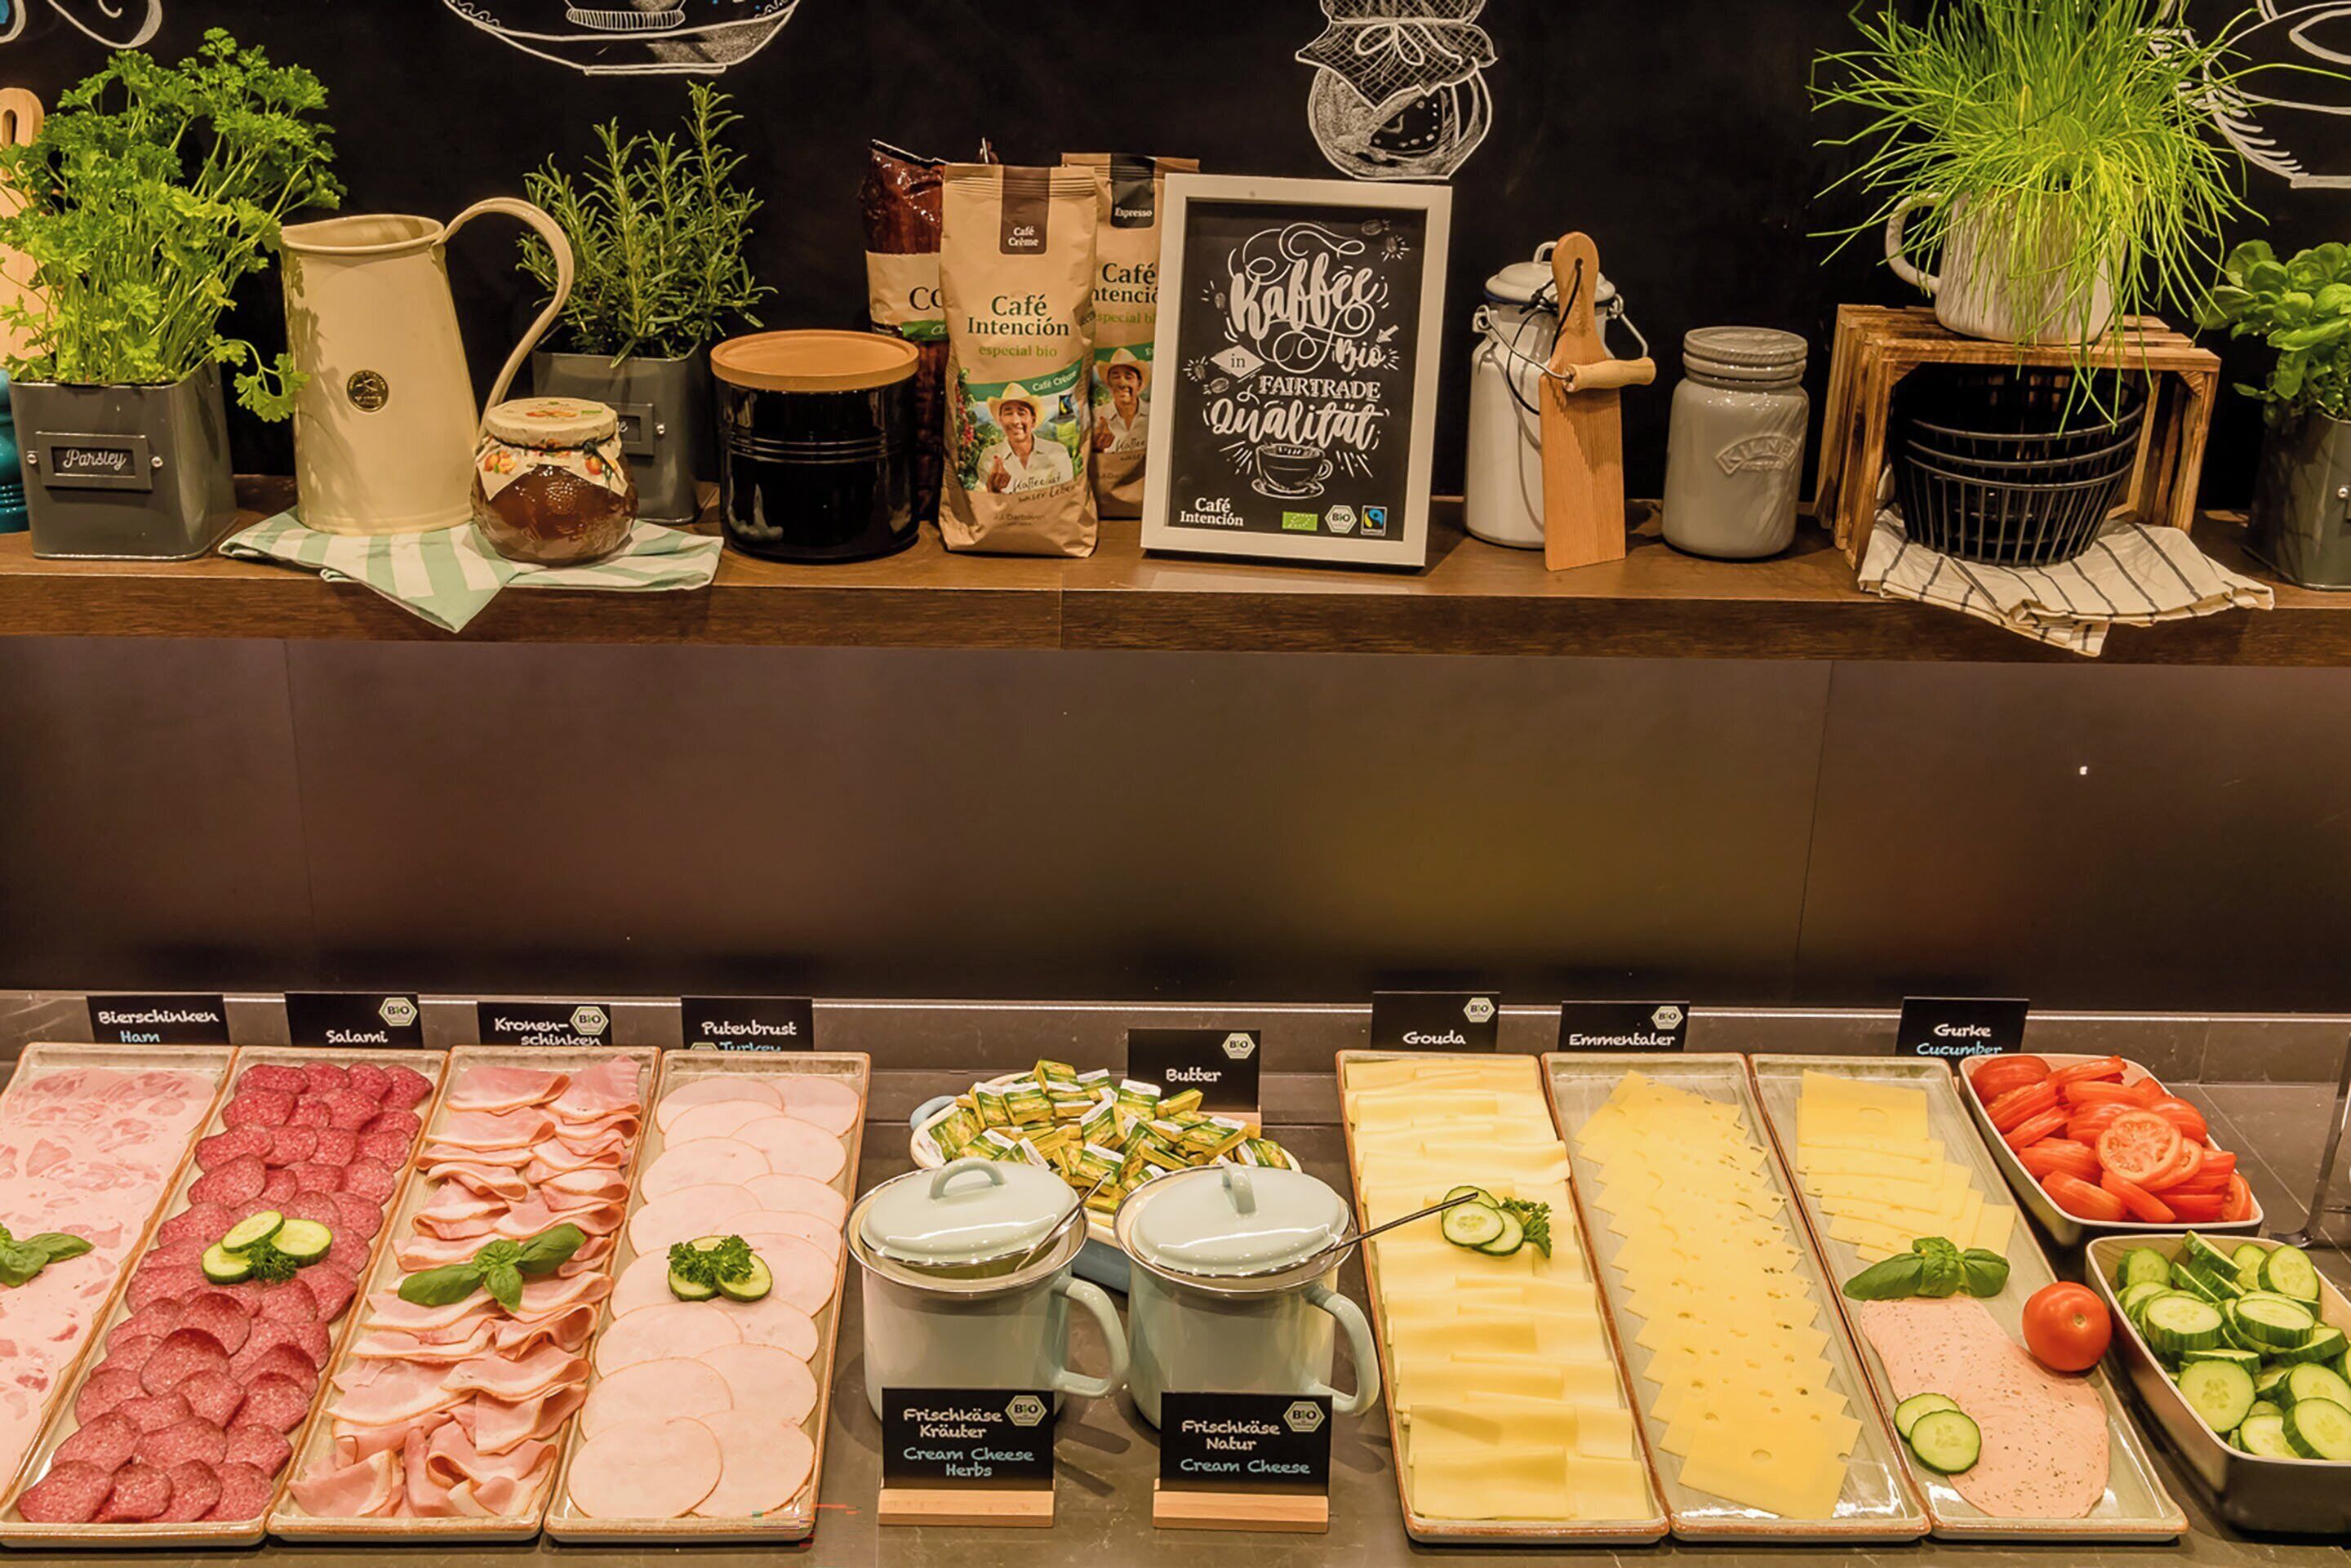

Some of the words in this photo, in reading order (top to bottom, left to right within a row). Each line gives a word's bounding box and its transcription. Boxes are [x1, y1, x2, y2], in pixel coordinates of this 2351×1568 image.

[1114, 207, 1153, 219] Espresso
[1013, 225, 1035, 236] Café
[1102, 262, 1156, 285] Café
[1229, 251, 1380, 341] Kaffee
[991, 293, 1047, 317] Café
[1096, 312, 1141, 324] special
[967, 317, 1069, 336] Intención
[979, 344, 1032, 358] especial
[1035, 345, 1058, 357] bio
[1335, 337, 1386, 372] Bio
[1230, 353, 1247, 368] in
[1032, 380, 1052, 392] Café
[1257, 375, 1382, 402] FAIRTRADE
[1210, 398, 1385, 451] Qualität
[62, 449, 127, 471] Parsley
[1195, 497, 1231, 513] Café
[1180, 510, 1244, 527] Intención
[98, 1009, 220, 1024] Bierschinken
[494, 1017, 569, 1032] Kronen-
[702, 1019, 797, 1036] Putenbrust
[1933, 1024, 1992, 1037] Gurke
[120, 1030, 160, 1043] Ham
[326, 1029, 389, 1044] Salami
[521, 1033, 602, 1046] schinken
[1402, 1029, 1466, 1045] Gouda
[1569, 1032, 1676, 1046] Emmentaler
[1916, 1040, 2002, 1056] Cucumber
[1166, 1066, 1222, 1082] Butter
[903, 1407, 1003, 1423] Frischkäse
[919, 1424, 987, 1439] Kräuter
[1181, 1419, 1281, 1436] Frischkäse
[1206, 1436, 1257, 1450] Natur
[903, 1446, 964, 1461] Cream
[970, 1447, 1035, 1462] Cheese
[944, 1462, 993, 1477] Herbs
[1180, 1458, 1241, 1472] Cream
[1247, 1459, 1311, 1474] Cheese
